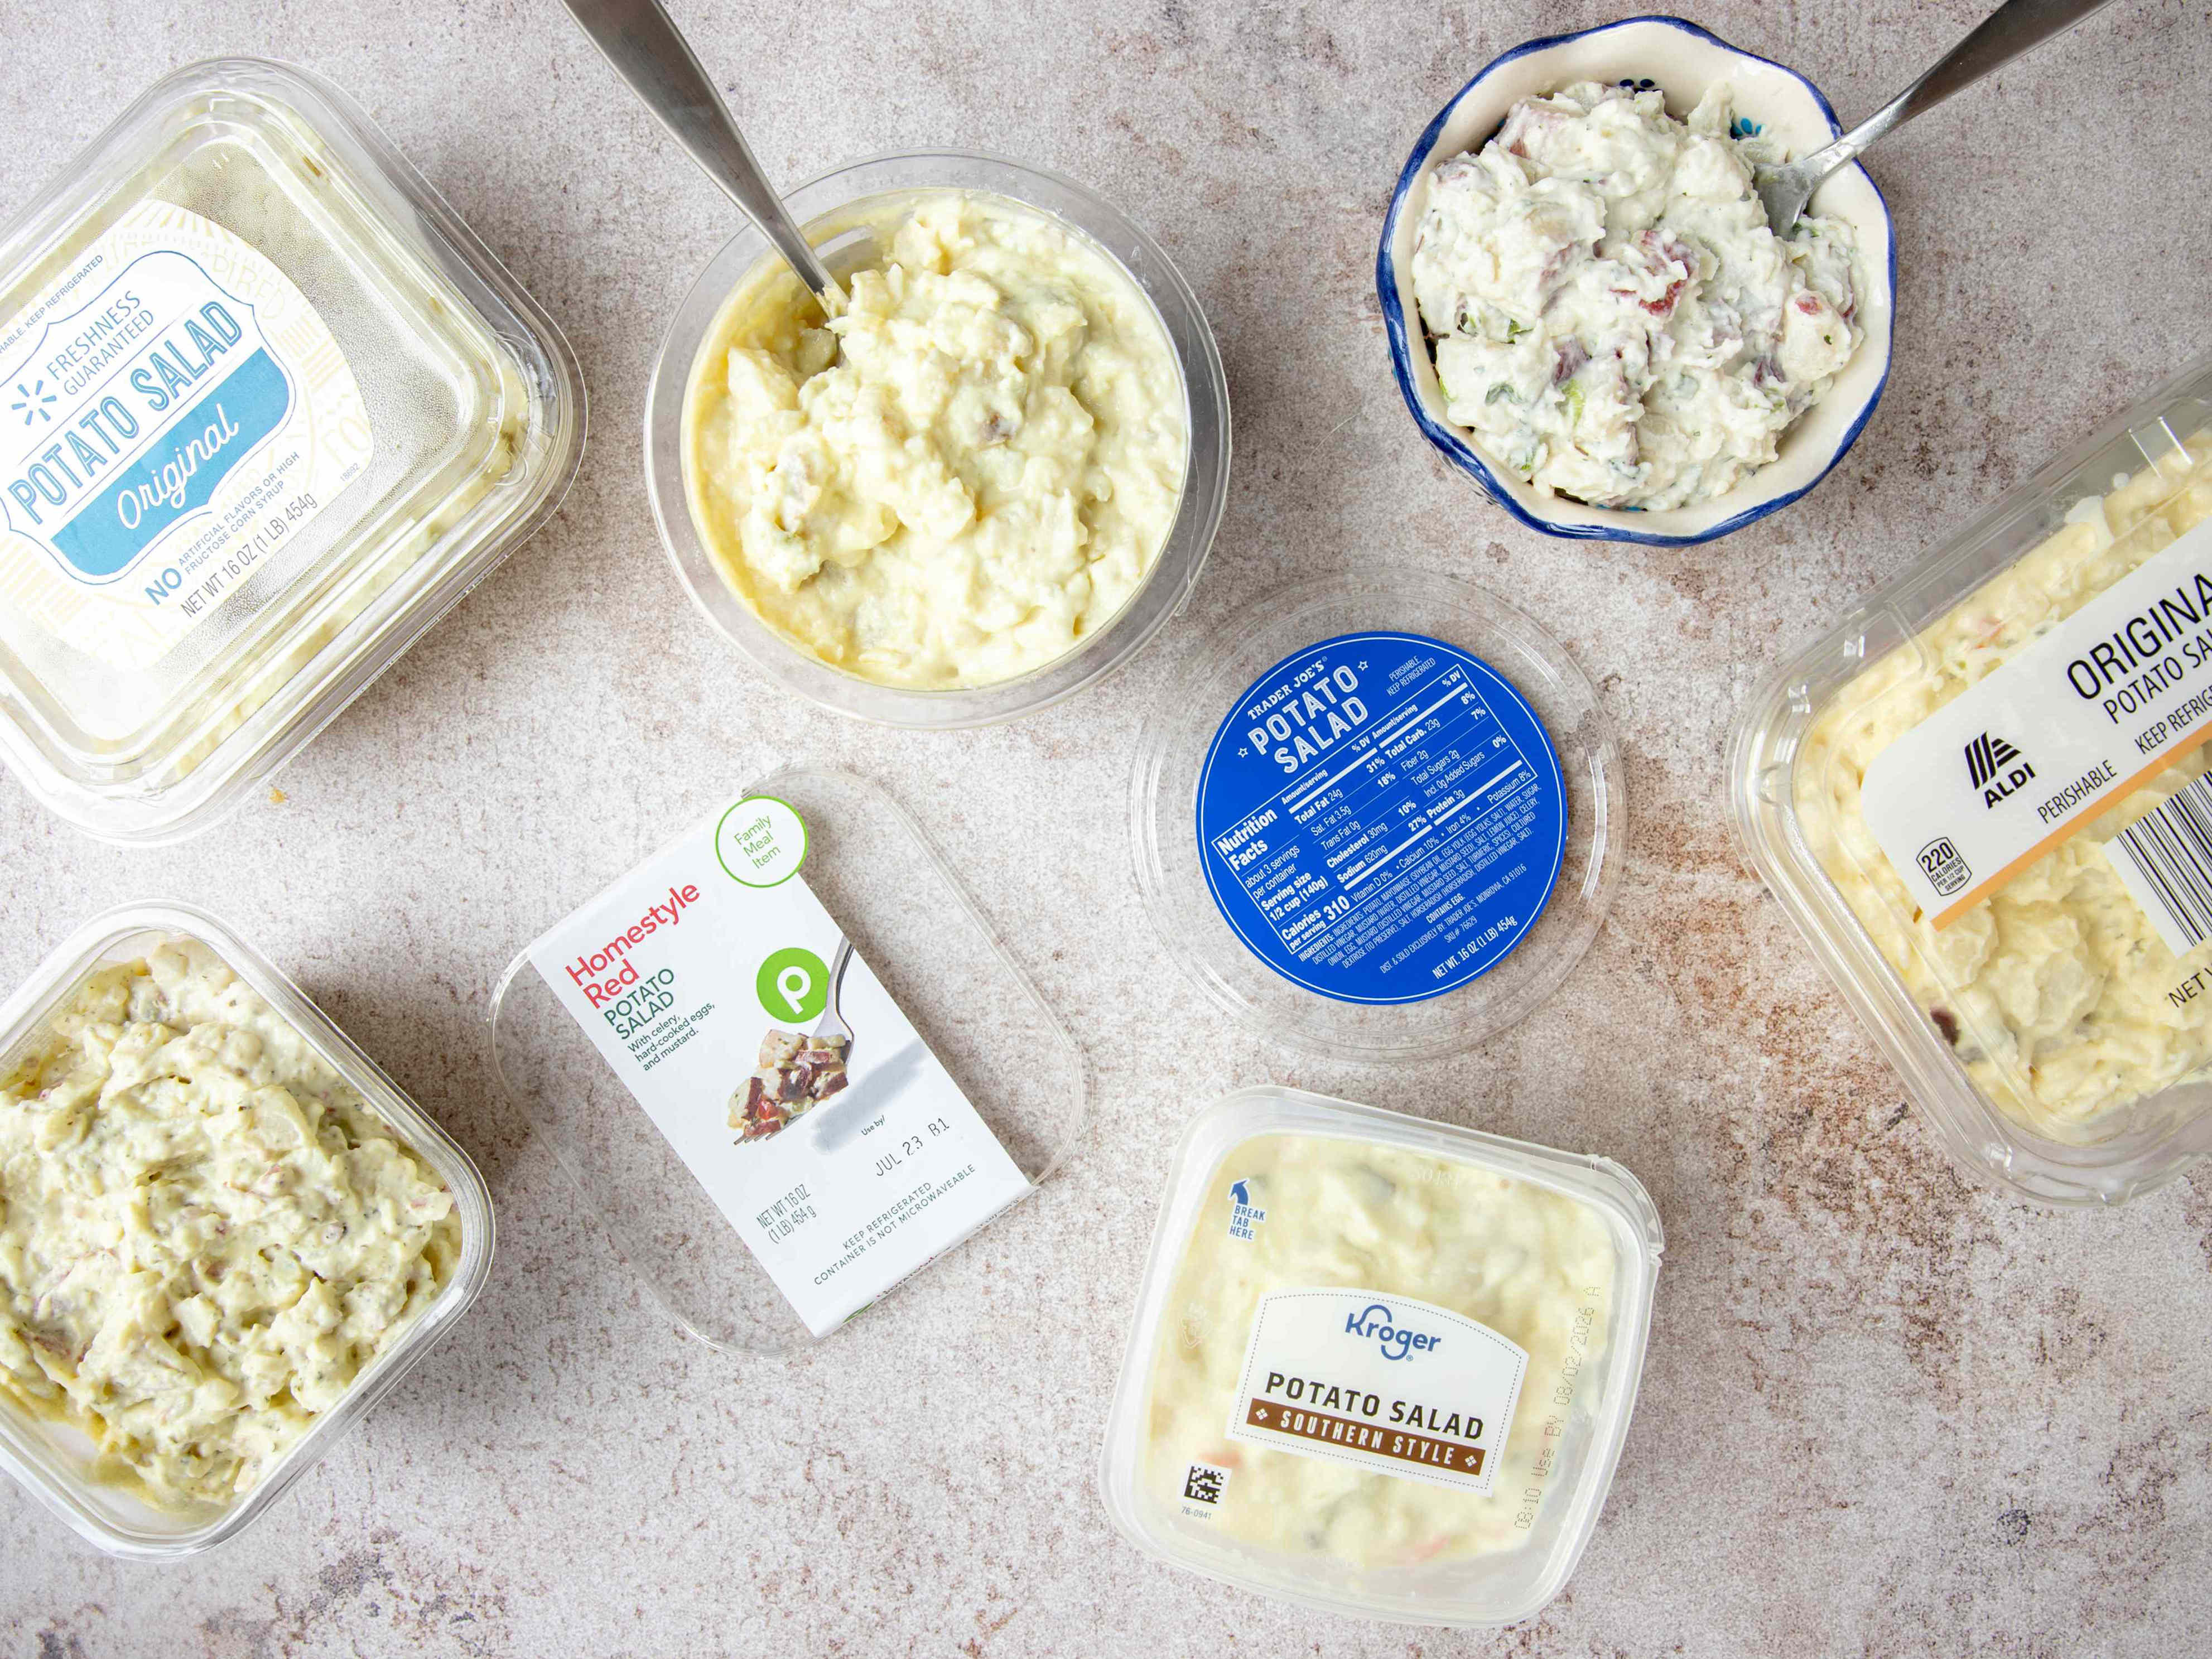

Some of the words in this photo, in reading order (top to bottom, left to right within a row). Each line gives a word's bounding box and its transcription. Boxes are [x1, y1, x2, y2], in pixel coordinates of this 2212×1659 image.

[25, 307, 45, 329] KEEP
[45, 255, 103, 308] REFRIGERATED
[46, 290, 140, 380] FRESHNESS
[64, 310, 154, 395] GUARANTEED
[7, 396, 139, 525] POTATO
[130, 301, 242, 412] SALAD
[117, 403, 239, 529] Original
[178, 523, 225, 567] ARTIFICIAL
[224, 486, 263, 523] FLAVORS
[263, 472, 277, 487] OR
[276, 451, 300, 475] HIGH
[184, 531, 231, 575] FRUCTOSE
[230, 508, 256, 532] CORN
[256, 480, 284, 509] SYRUP
[180, 589, 206, 618] NET
[201, 572, 224, 597] WT
[222, 560, 241, 580] 16
[236, 543, 258, 566] OZ
[253, 533, 268, 554] (1
[264, 517, 290, 541] LB)
[285, 493, 317, 521] 454g
[144, 568, 182, 606] NO
[2066, 571, 2212, 701] ORIGINA
[1247, 684, 1293, 720] TRADER
[1294, 660, 1324, 688] JOE'S
[1386, 682, 1400, 696] KEEP
[1399, 657, 1436, 687] REFRIGERATED
[2102, 655, 2184, 725] POTATO
[1247, 665, 1358, 755] POTATO
[1372, 704, 1418, 740] Amount/serving
[1385, 740, 1407, 759] Total
[1405, 729, 1427, 745] Carb.
[1425, 718, 1440, 731] 23g
[1461, 691, 1476, 705] 8%
[2134, 721, 2167, 755] KEEP
[2167, 684, 2212, 732] REFRIG
[1274, 696, 1368, 774] SALAD
[1358, 736, 1370, 747] DV
[1400, 756, 1419, 771] Fiber
[1416, 750, 1429, 760] 2g
[1471, 707, 1486, 720] 7%
[1410, 769, 1429, 785] Total
[1427, 756, 1451, 775] Sugars
[1448, 749, 1461, 759] 2g
[1444, 764, 1466, 784] Added
[1462, 751, 1485, 770] Sugars
[1492, 735, 1507, 748] 0%
[1281, 769, 1328, 805] Amount/serving
[1294, 806, 1317, 824] Total
[1314, 797, 1330, 811] Fat
[1327, 789, 1343, 802] 24g
[1366, 756, 1385, 773] 31%
[1323, 814, 1337, 827] Fat
[1334, 805, 1352, 819] 3.5g
[1377, 771, 1396, 788] 18%
[1426, 796, 1456, 819] Protein
[1453, 789, 1466, 799] 3g
[1487, 778, 1521, 804] Potassium
[1984, 762, 2036, 809] ALDI
[2037, 759, 2117, 824] PERISHABLE
[734, 816, 771, 848] Family
[743, 830, 774, 857] Meal
[1217, 809, 1278, 856] Nutrition
[1321, 834, 1341, 850] Trans
[1337, 826, 1352, 838] Fat
[1349, 821, 1361, 831] 0g
[1326, 833, 1370, 868] Cholesterol
[1367, 822, 1389, 839] 30mg
[1398, 800, 1416, 816] 10%
[1337, 860, 1366, 883] Sodium
[1364, 845, 1389, 864] 620mg
[1408, 815, 1427, 832] 27%
[1445, 821, 1461, 834] Iron
[751, 846, 780, 869] Item
[1228, 840, 1268, 871] Facts
[1245, 869, 1266, 889] about
[1270, 845, 1300, 870] servings
[1399, 847, 1425, 868] Calcium
[1423, 836, 1439, 850] 10%
[1921, 842, 1954, 873] 220
[1931, 857, 1962, 882] CALORIES
[1252, 885, 1266, 901] per
[1265, 863, 1297, 890] container
[1261, 884, 1295, 911] Serving
[1293, 872, 1312, 889] size
[1269, 906, 1285, 921] 1/2
[1284, 896, 1301, 912] cup
[1299, 875, 1328, 902] (140g)
[1350, 883, 1376, 903] Vitamin
[1936, 877, 1948, 888] PER
[1954, 865, 1964, 875] CUP
[1945, 874, 1966, 891] SERVING
[1281, 910, 1322, 941] Calories
[1323, 895, 1350, 920] 310
[1289, 937, 1302, 951] per
[1301, 920, 1327, 941] serving
[1425, 901, 1453, 924] CONTAINS
[565, 885, 700, 992] Homestyle
[1432, 963, 1448, 979] NET
[1457, 948, 1470, 961] 16
[1467, 941, 1480, 954] OZ
[1497, 915, 1518, 932] 454g
[582, 958, 640, 1009] Red
[604, 968, 674, 1026] POTATO
[2168, 972, 2208, 1009] NET
[615, 991, 674, 1040] SALAD
[627, 1035, 652, 1052] With
[651, 1015, 680, 1036] celery,
[634, 1017, 690, 1062] hard-cooked
[690, 1003, 715, 1022] eggs,
[643, 1053, 661, 1071] and
[660, 1026, 699, 1058] mustard.
[861, 1125, 875, 1136] Use
[873, 1115, 885, 1127] by/
[876, 1153, 902, 1176] JUL
[902, 1136, 923, 1156] 23
[928, 1118, 950, 1136] B1
[756, 1209, 775, 1229] NET
[770, 1199, 788, 1217] WT
[784, 1192, 799, 1208] 16
[794, 1183, 811, 1200] OZ
[768, 1228, 780, 1245] (1
[776, 1219, 794, 1237] LB)
[791, 1207, 809, 1225] 454
[806, 1205, 817, 1218] g
[814, 1245, 866, 1285] CONTAINER
[866, 1237, 876, 1247] IS
[876, 1221, 897, 1239] NOT
[898, 1164, 975, 1224] MICROWAVEABLE
[842, 1230, 865, 1250] KEEP
[866, 1182, 931, 1233] REFRIGERATED
[1232, 1215, 1249, 1228] TAB
[1235, 1204, 1265, 1221] BREAK
[1230, 1225, 1254, 1240] HERE
[1345, 1304, 1442, 1362] Kroger
[1265, 1372, 1380, 1417] POTATO
[1389, 1400, 1483, 1440] SALAD
[1280, 1410, 1383, 1449] SOUTHERN
[1392, 1435, 1454, 1465] STYLE
